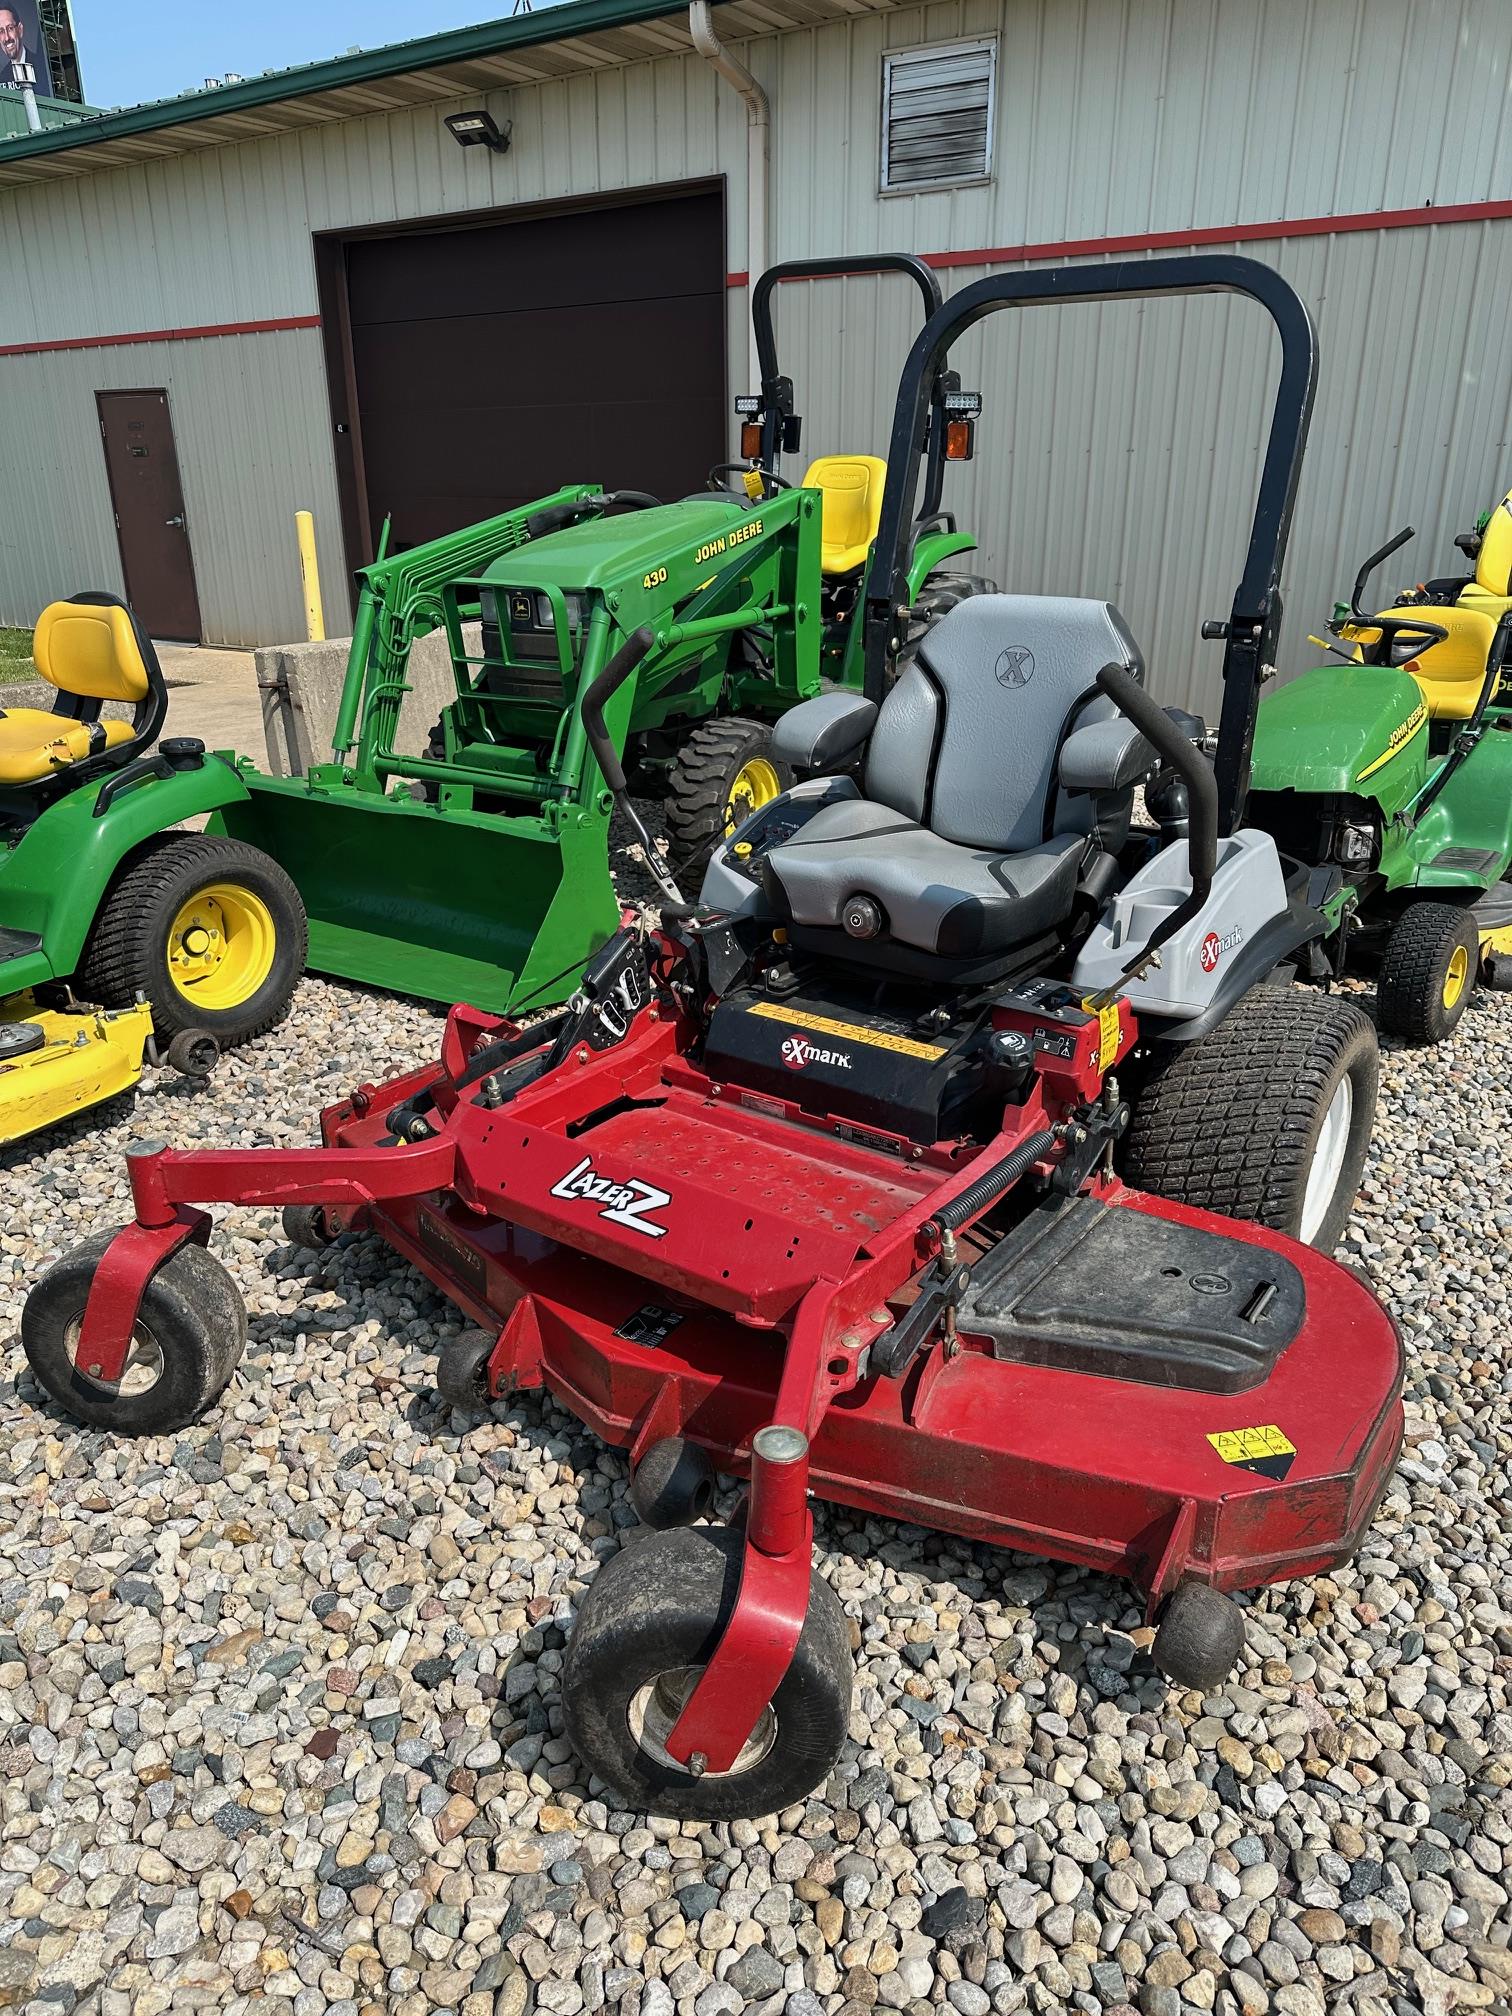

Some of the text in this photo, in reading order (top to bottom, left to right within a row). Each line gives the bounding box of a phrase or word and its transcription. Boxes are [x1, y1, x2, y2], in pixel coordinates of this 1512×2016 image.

[694, 519, 763, 564] JOHN DEERE
[643, 566, 668, 589] 430
[1389, 703, 1424, 747] JOHN DEERE
[1200, 926, 1243, 968] eXmark
